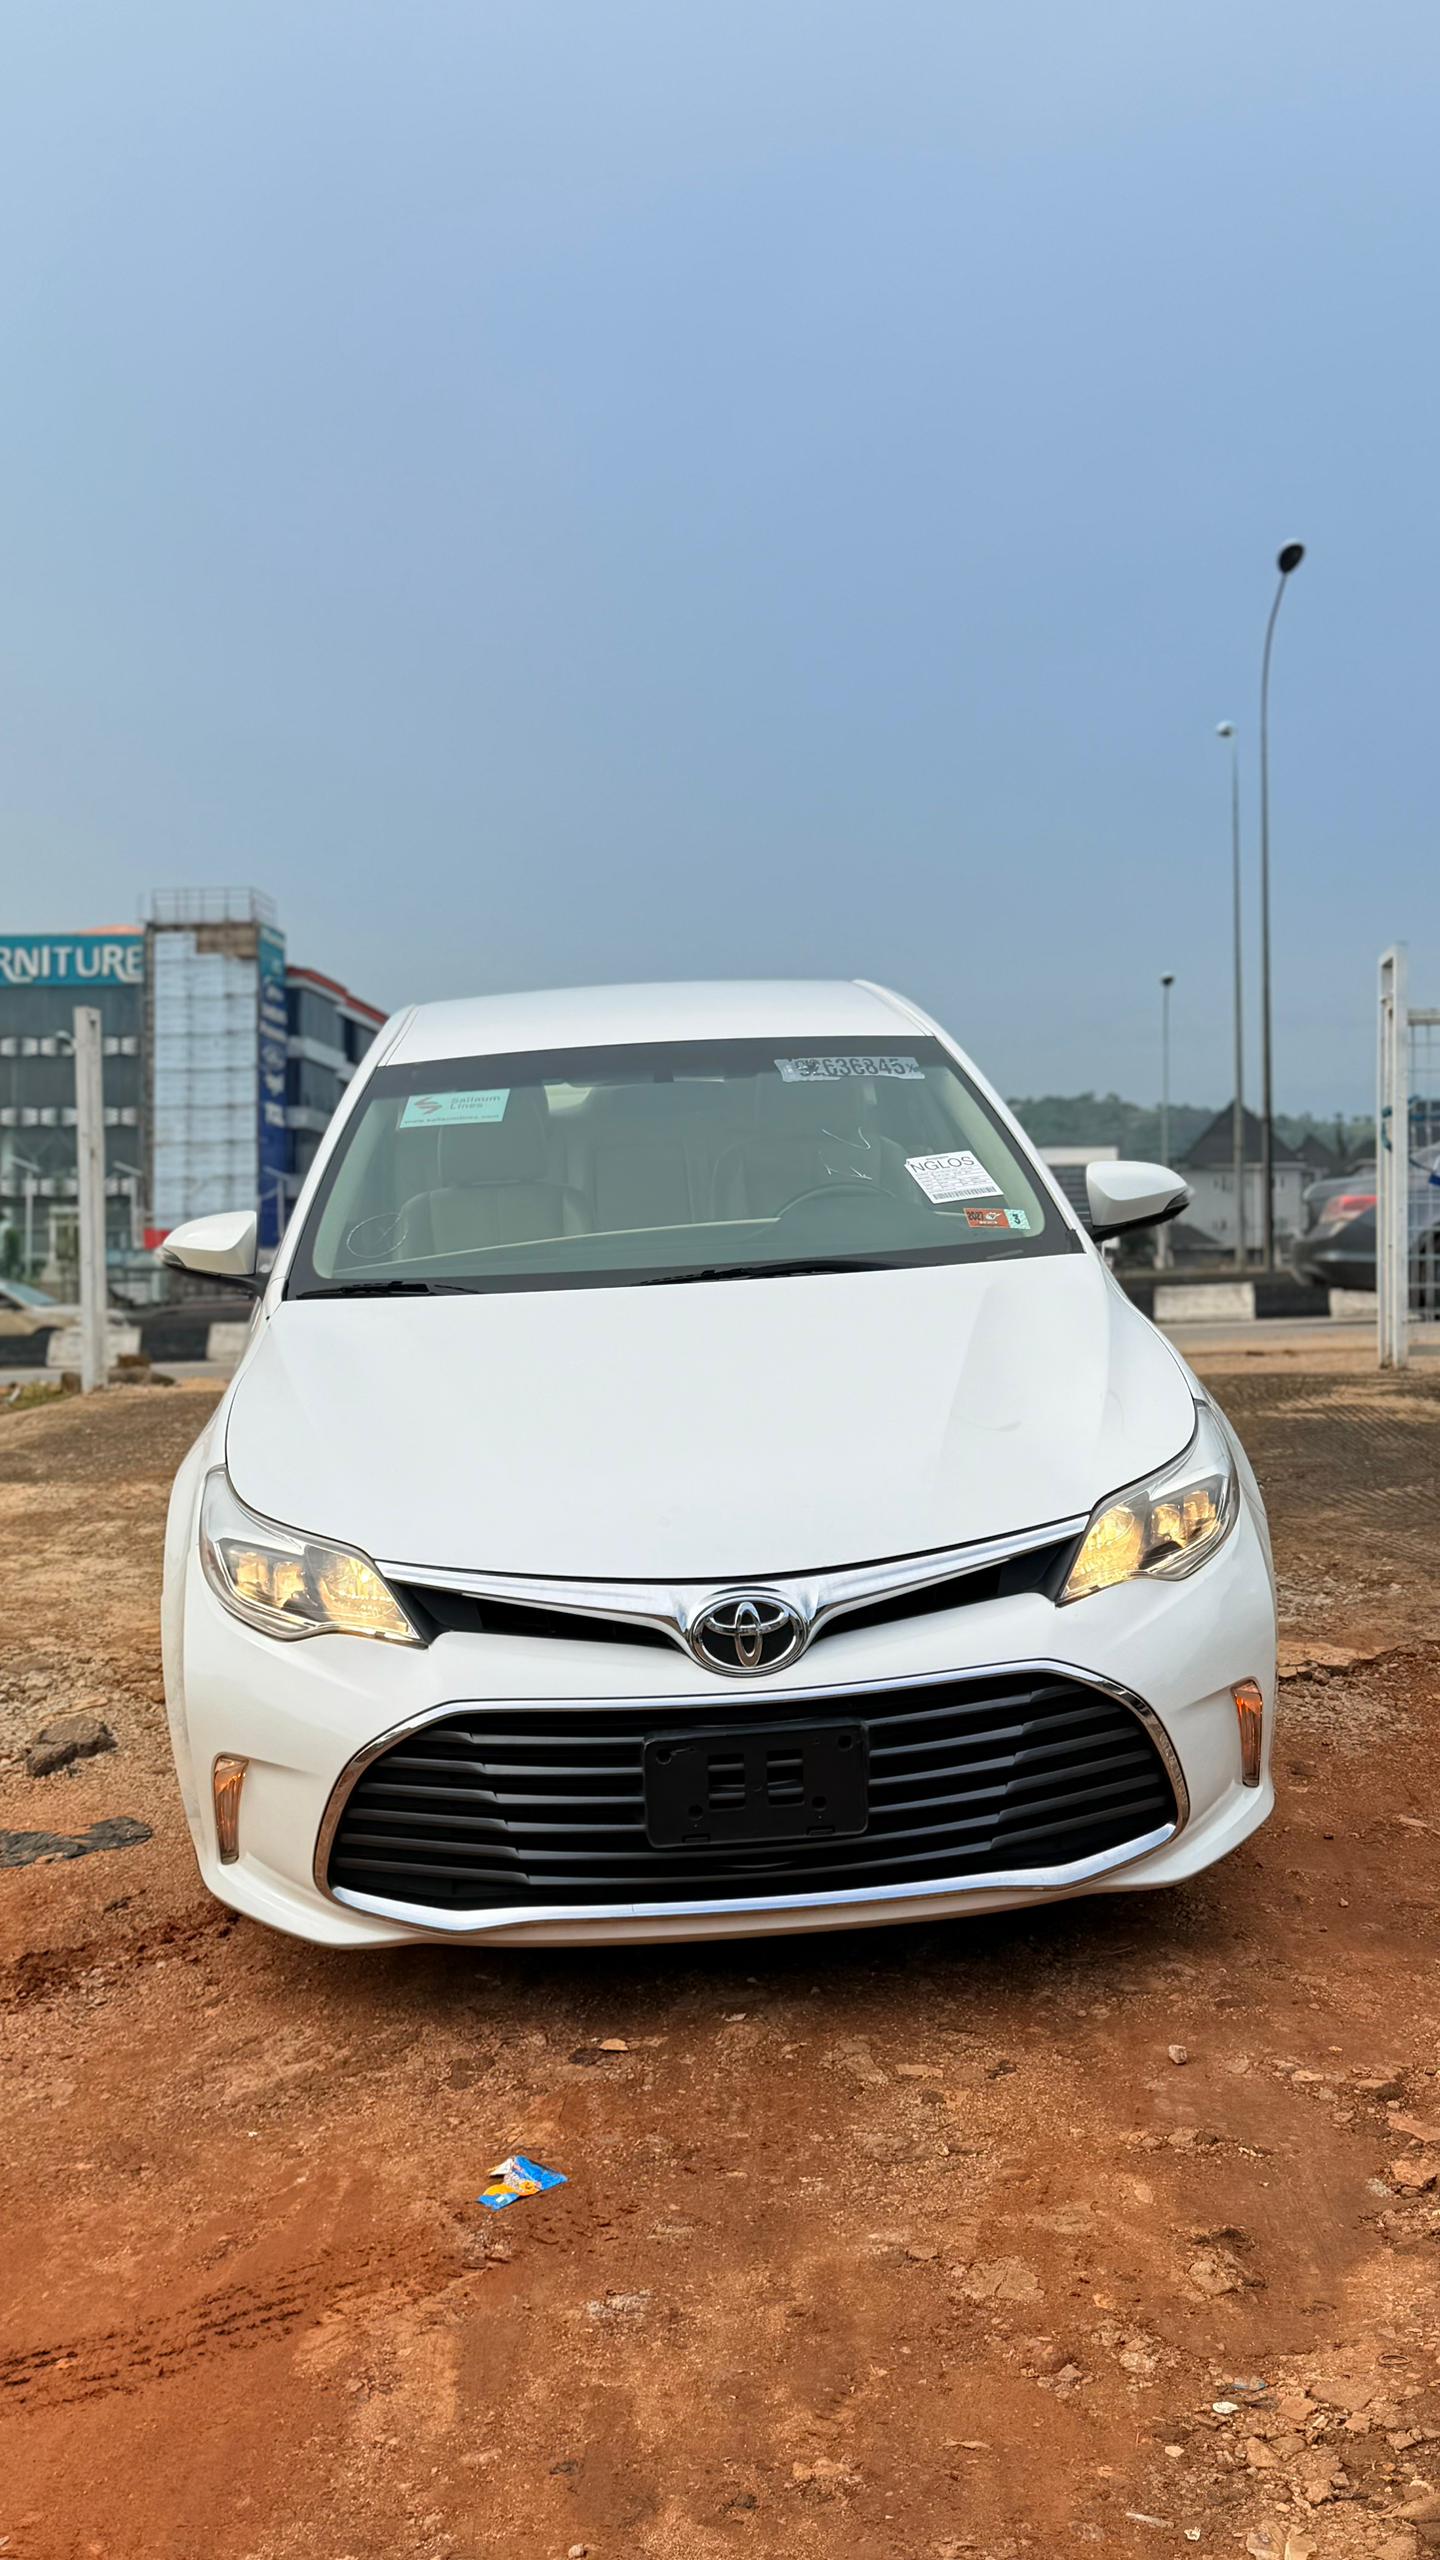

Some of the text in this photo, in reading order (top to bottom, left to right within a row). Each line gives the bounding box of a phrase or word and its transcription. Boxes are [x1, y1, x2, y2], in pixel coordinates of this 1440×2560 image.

[450, 1103, 484, 1111] Lines
[910, 1156, 975, 1173] NGLOS
[1012, 1213, 1020, 1224] 3
